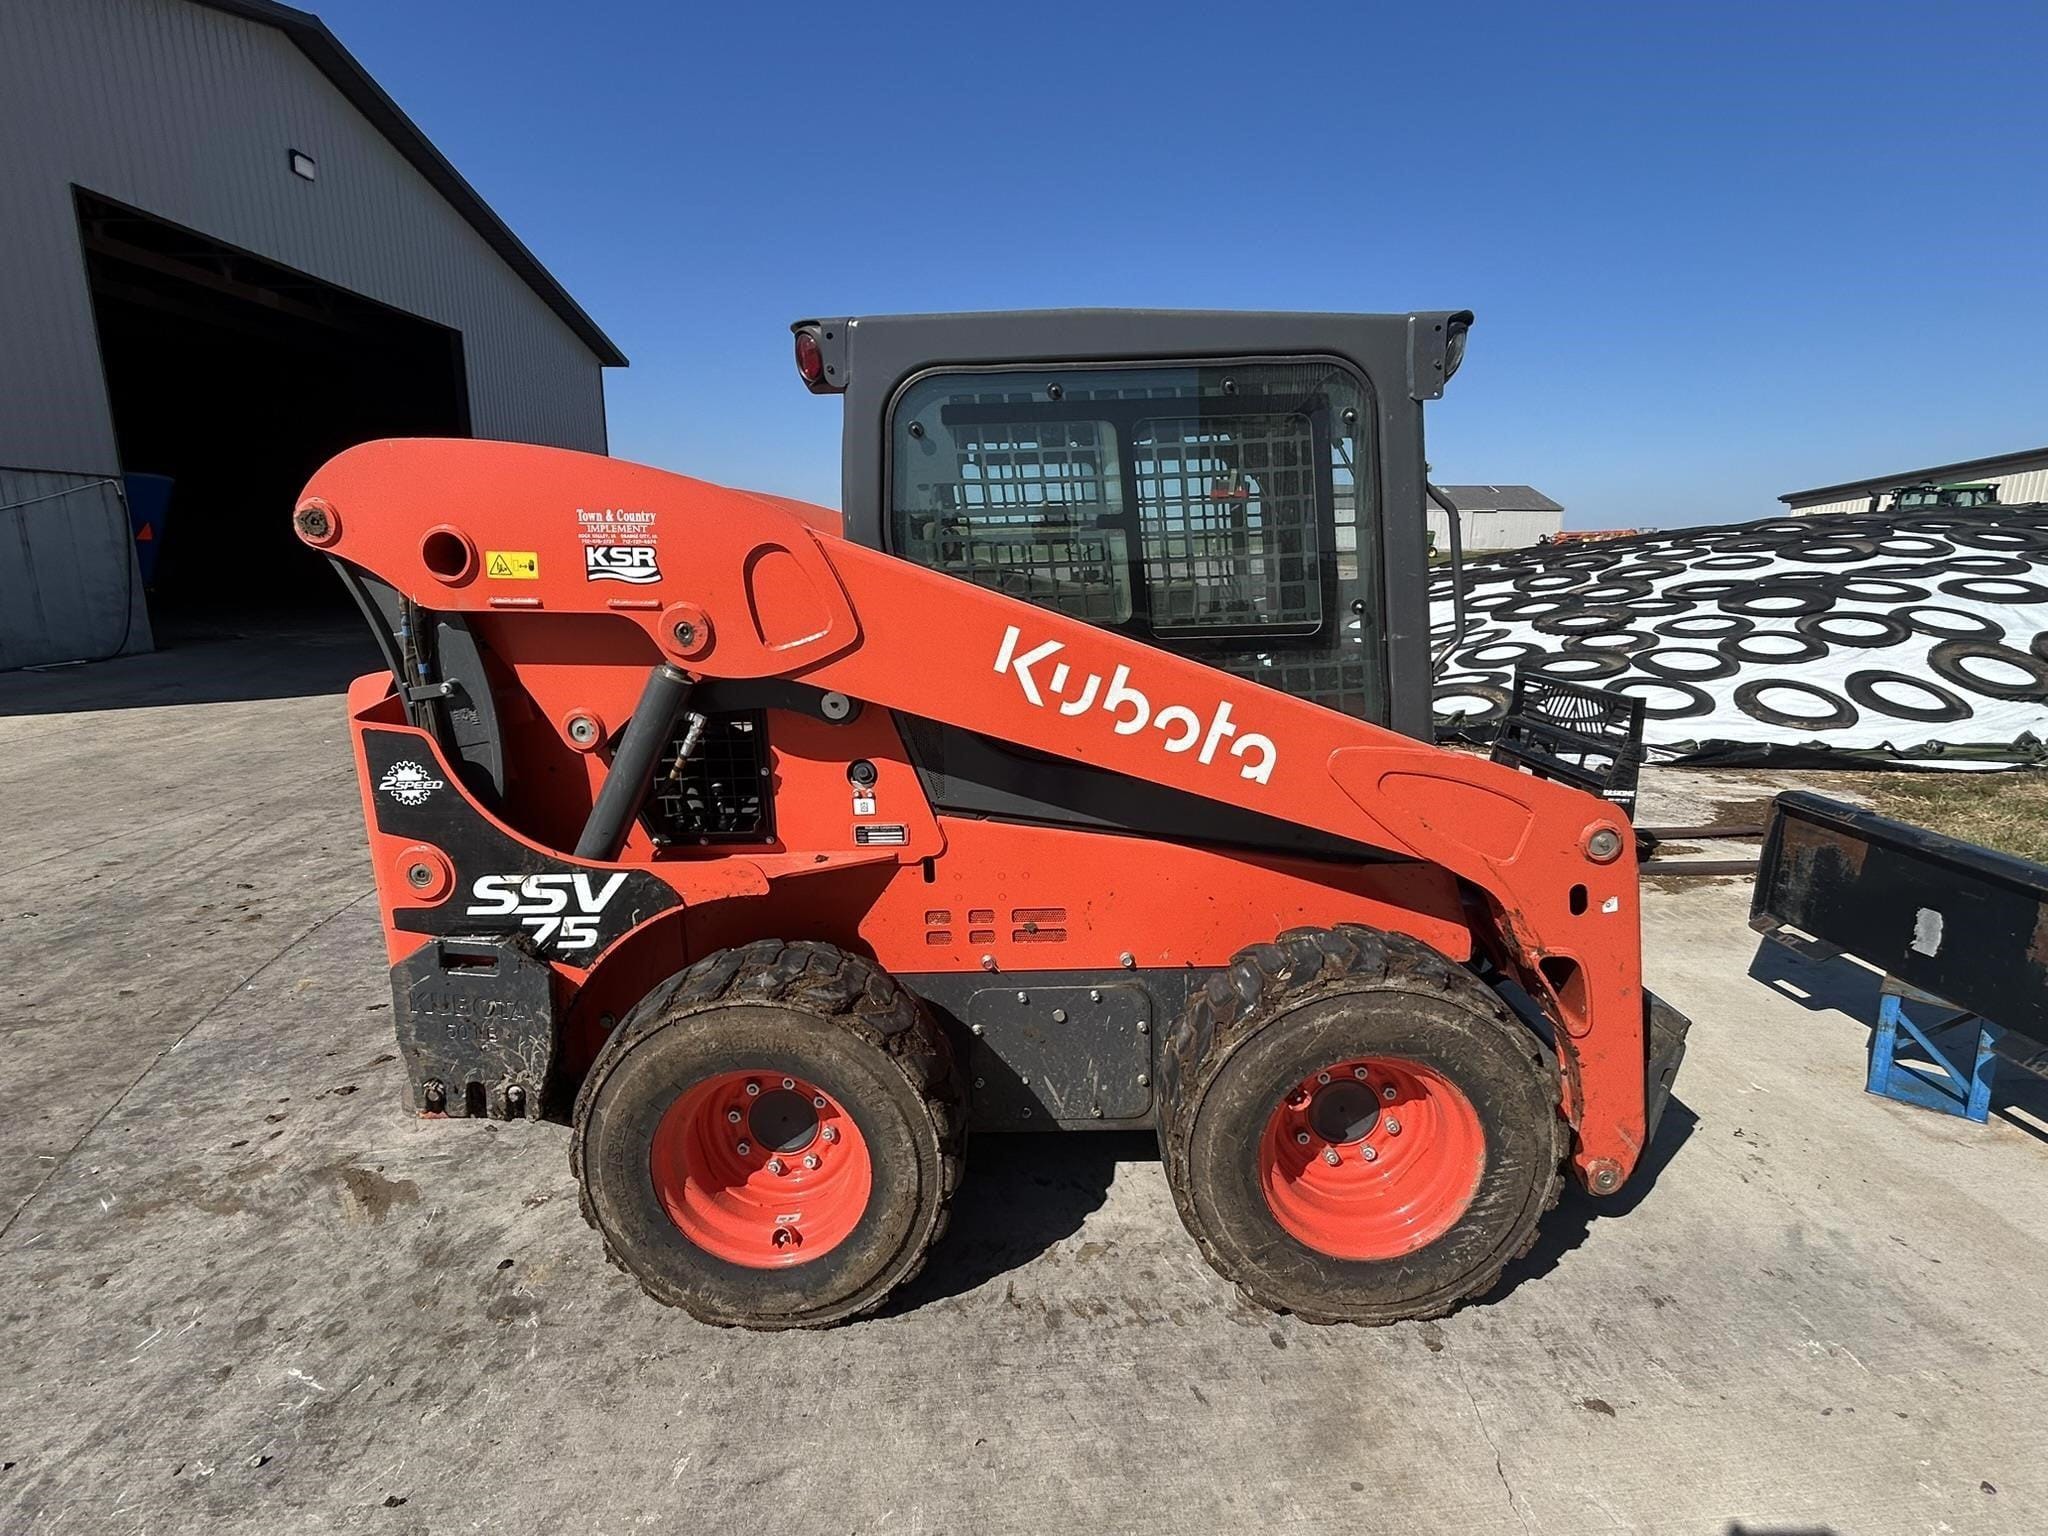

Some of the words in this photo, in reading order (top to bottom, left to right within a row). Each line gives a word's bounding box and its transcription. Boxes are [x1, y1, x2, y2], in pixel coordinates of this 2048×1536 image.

[576, 509, 602, 521] Town
[606, 509, 614, 521] &
[616, 509, 656, 525] Country
[587, 525, 647, 533] IMPLEMENT
[586, 546, 656, 566] KSR
[993, 624, 1277, 785] Kubota
[466, 873, 629, 915] SSV
[522, 916, 600, 949] 75
